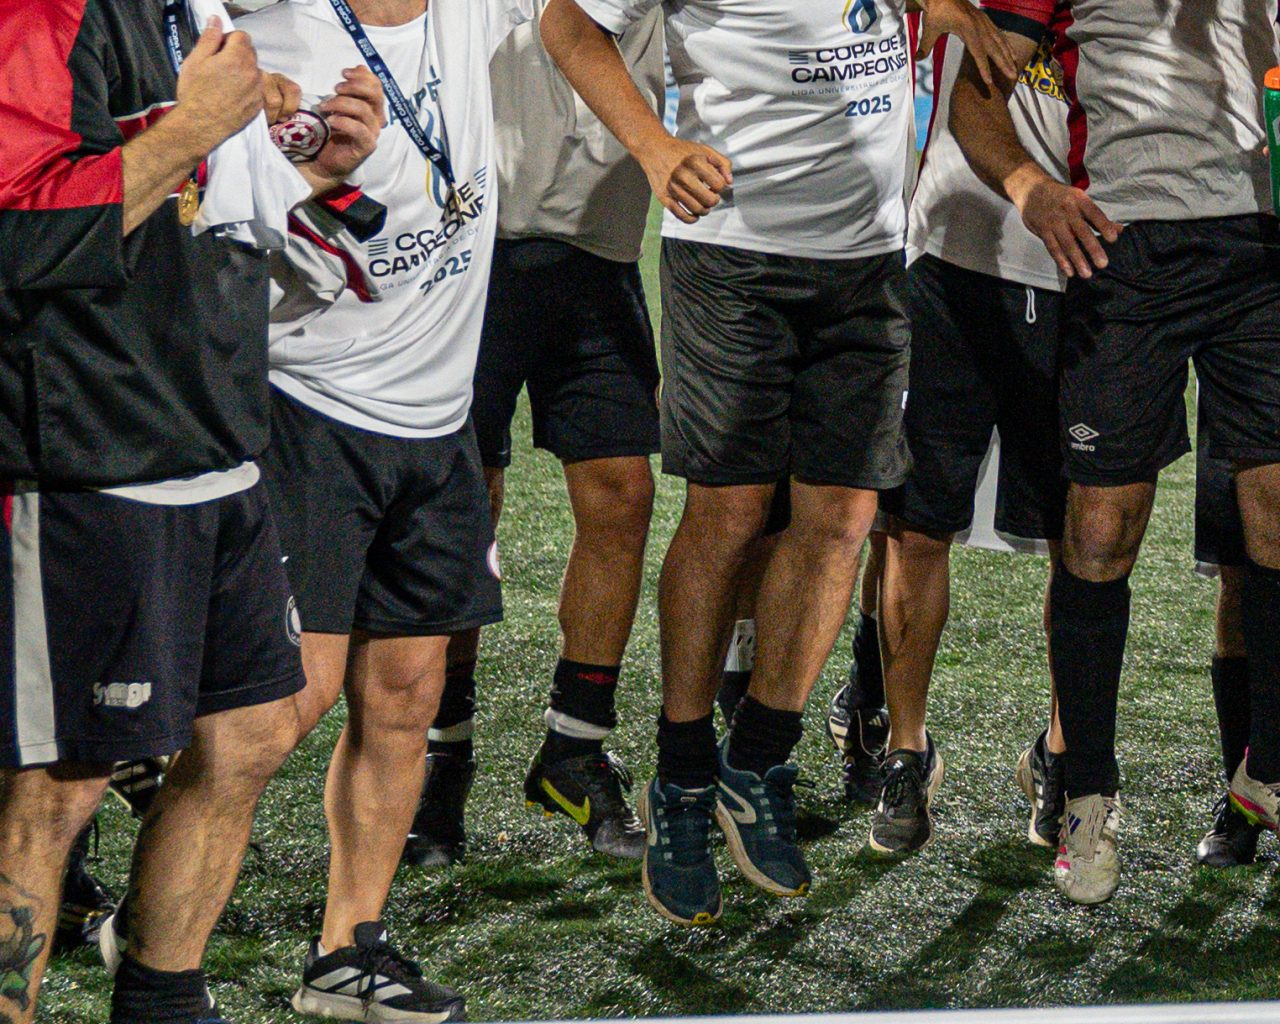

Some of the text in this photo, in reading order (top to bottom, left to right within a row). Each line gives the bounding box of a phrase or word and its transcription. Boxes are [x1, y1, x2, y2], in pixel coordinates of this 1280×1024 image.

[170, 24, 180, 48] COPA
[816, 34, 898, 64] COPA DE
[791, 50, 907, 84] CAMPEONE
[378, 73, 406, 118] CAMPEONES
[844, 94, 892, 117] 2025
[410, 126, 426, 146] COPA
